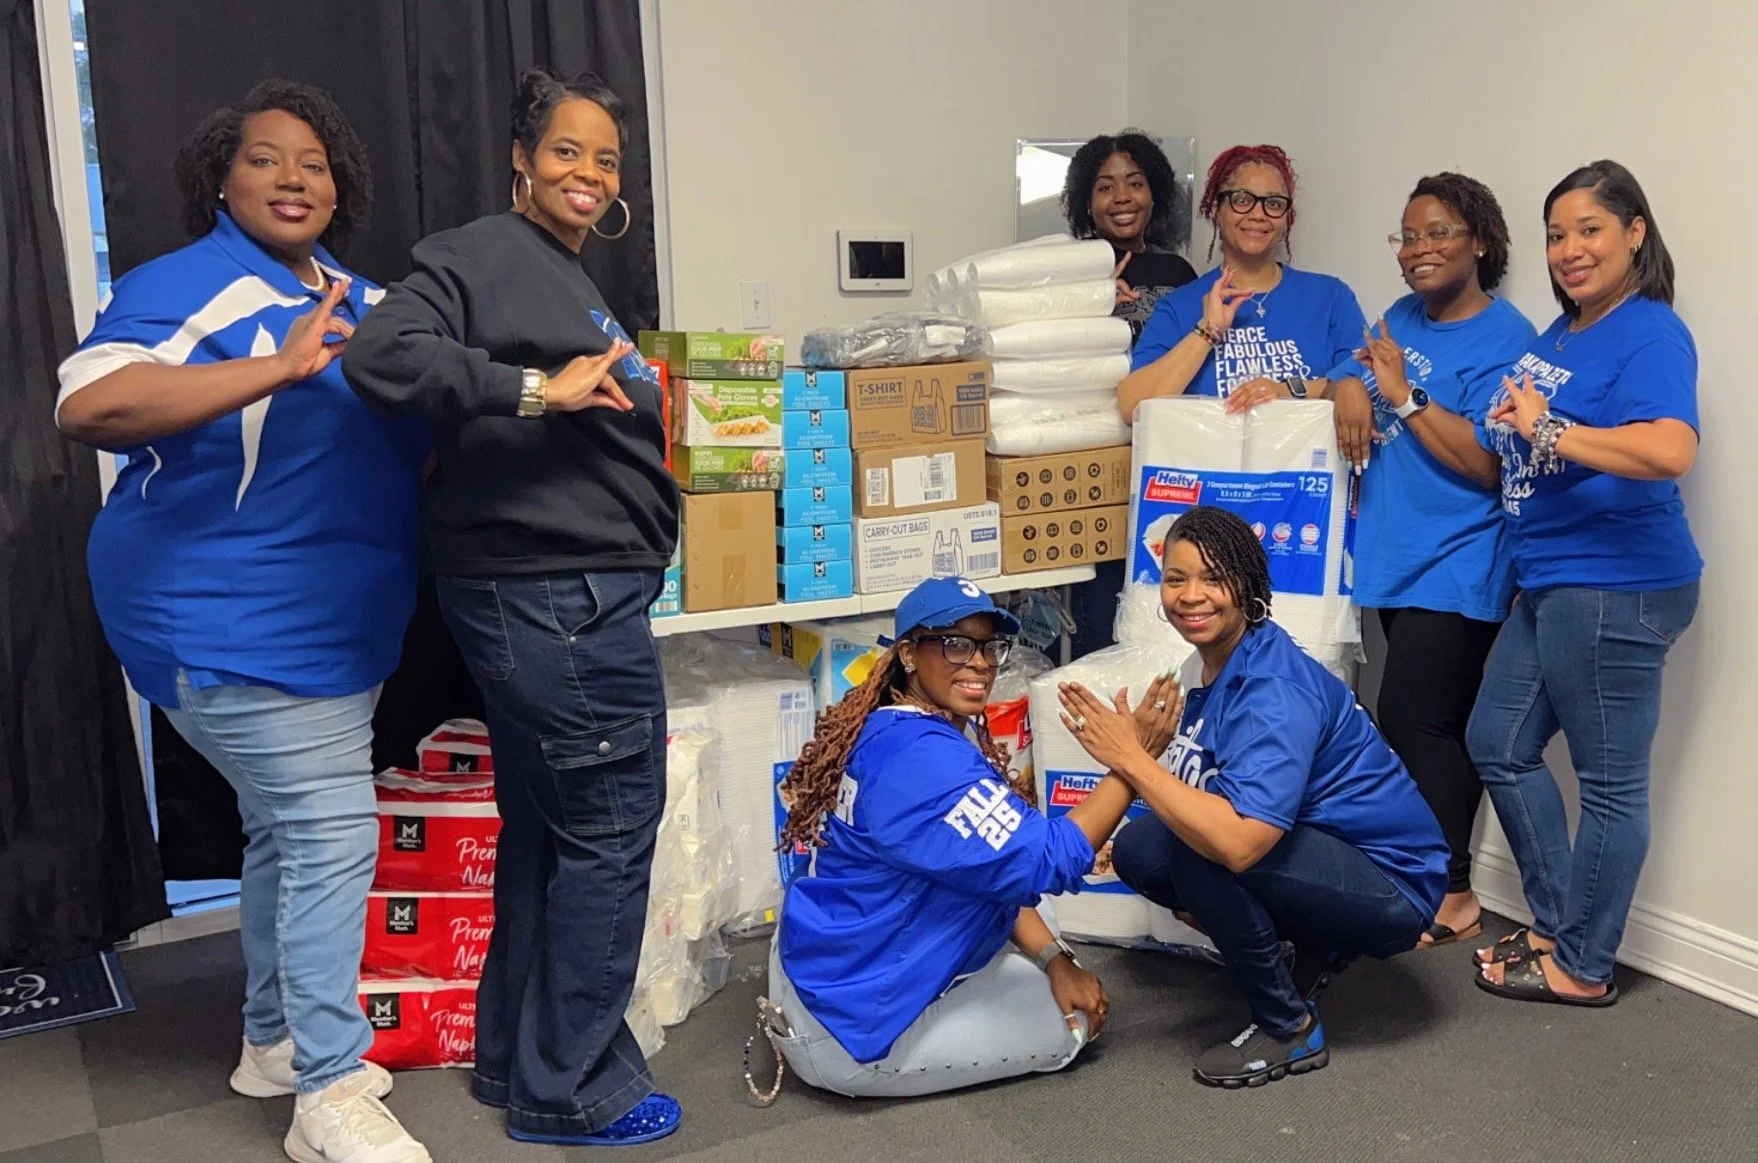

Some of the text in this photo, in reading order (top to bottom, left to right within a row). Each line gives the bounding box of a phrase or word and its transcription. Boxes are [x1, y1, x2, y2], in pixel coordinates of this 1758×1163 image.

[1222, 327, 1268, 344] IERCE
[1214, 340, 1299, 360] FABULOUS
[1215, 353, 1304, 379] FLAWLESS
[718, 386, 757, 394] Disposable
[857, 382, 903, 395] T-SHIRT
[1157, 471, 1195, 489] Hefty
[1298, 476, 1328, 492] 125
[1151, 488, 1195, 500] SUPREME
[866, 521, 928, 538] CARRY-OUT BAGS
[944, 778, 1009, 840] FALL
[402, 823, 418, 838] M
[978, 799, 1023, 852] 25
[394, 905, 411, 920] M
[449, 917, 494, 944] Prem
[375, 1000, 392, 1016] M
[431, 1010, 476, 1033] Prem
